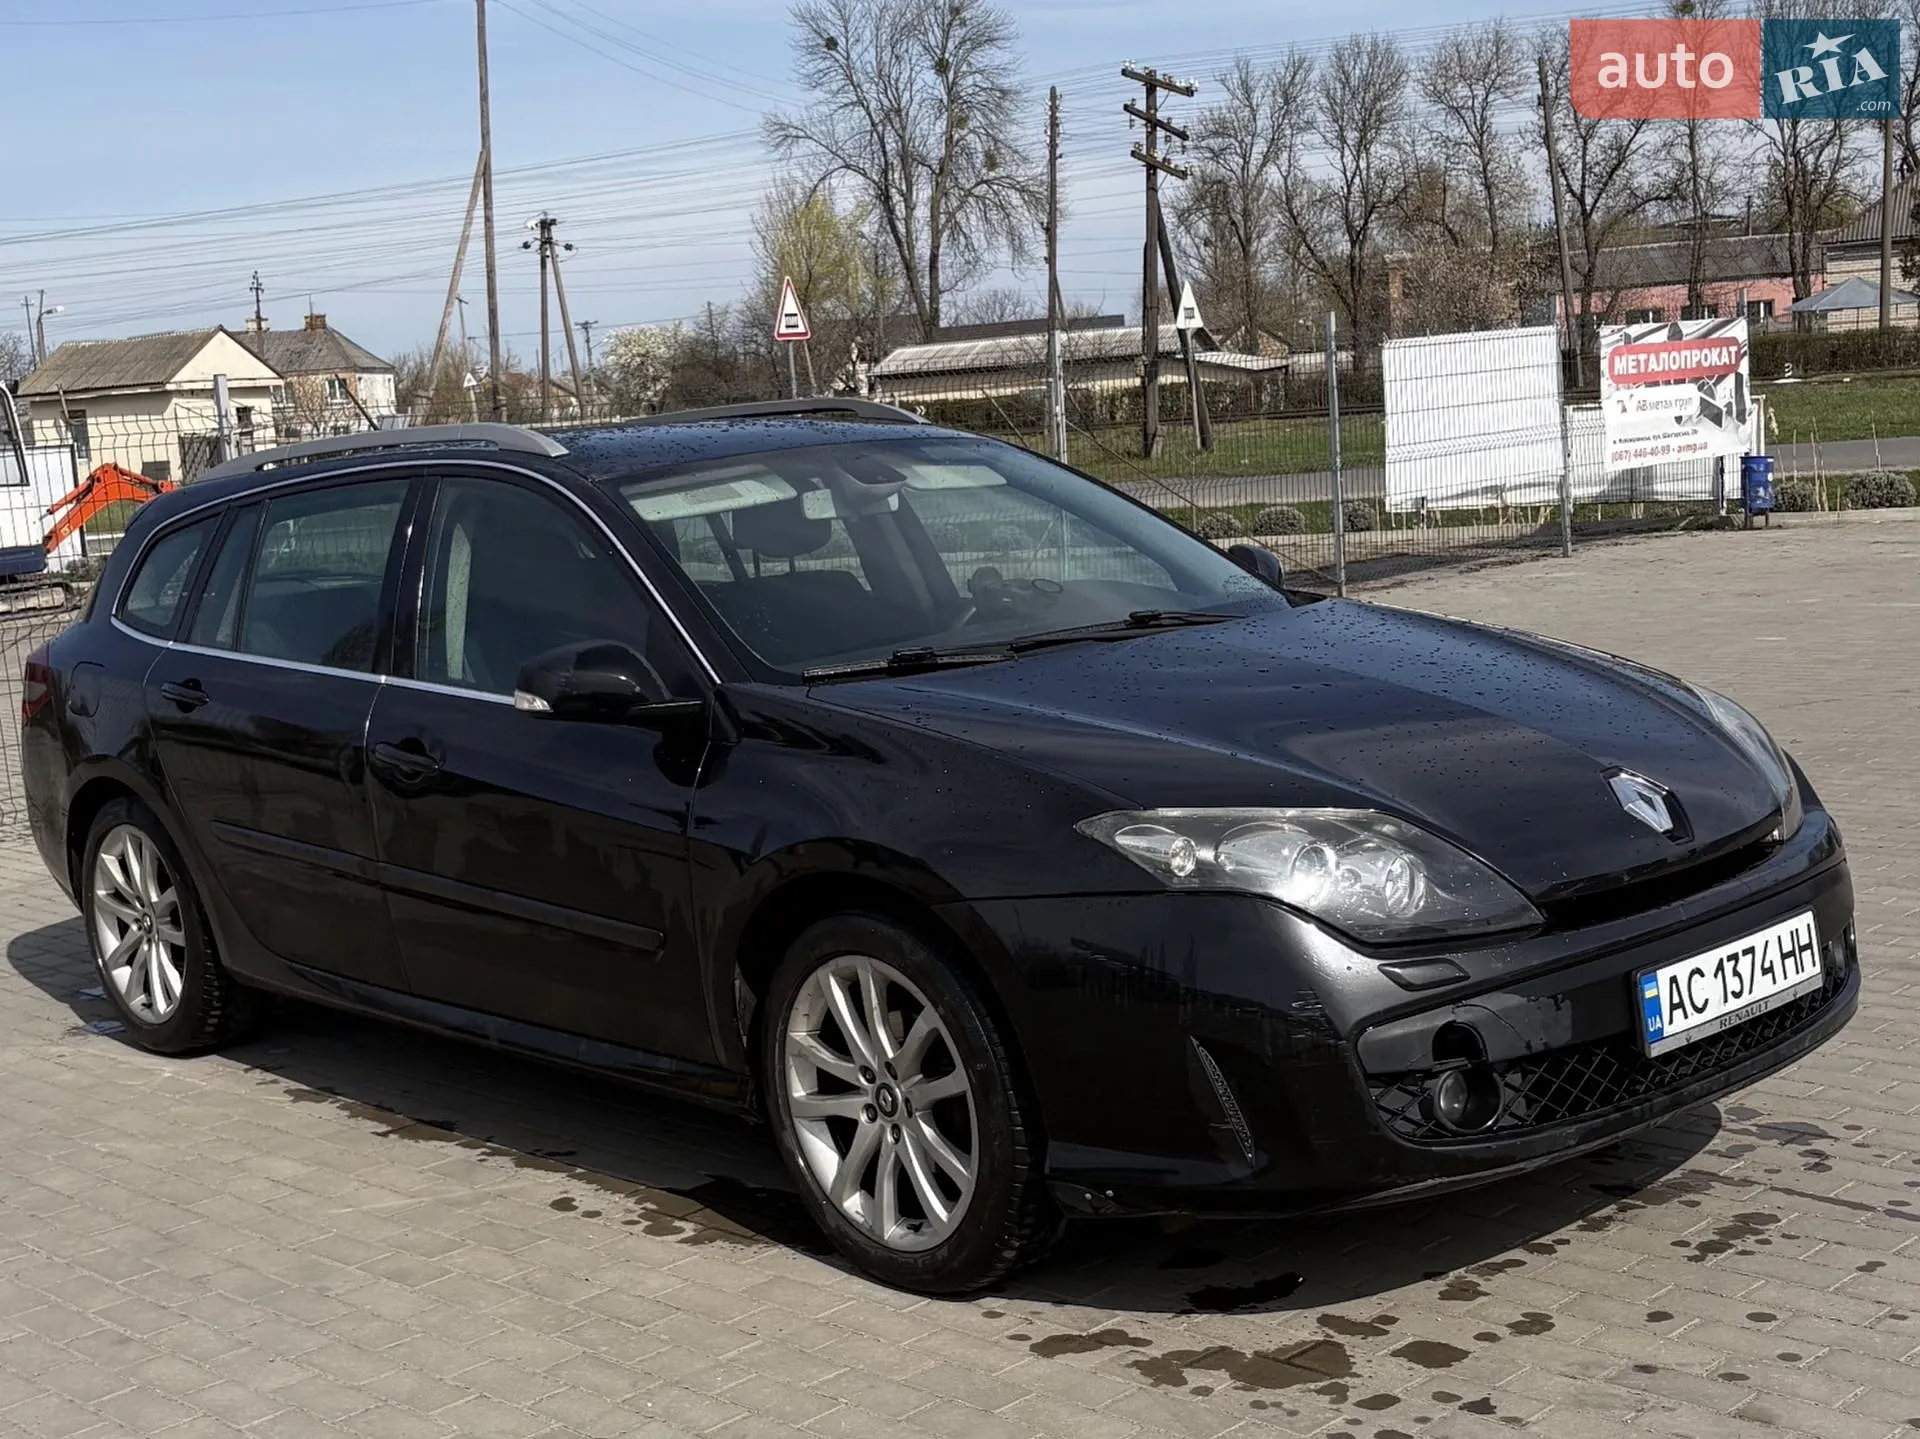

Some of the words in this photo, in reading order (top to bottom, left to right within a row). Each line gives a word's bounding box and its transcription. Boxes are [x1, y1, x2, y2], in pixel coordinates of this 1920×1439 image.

[1614, 345, 1738, 376] МЕТАЛОПРОКАТ
[1611, 448, 1632, 464] (067)
[1647, 1015, 1662, 1032] UA
[1719, 1000, 1770, 1029] RENAULT
